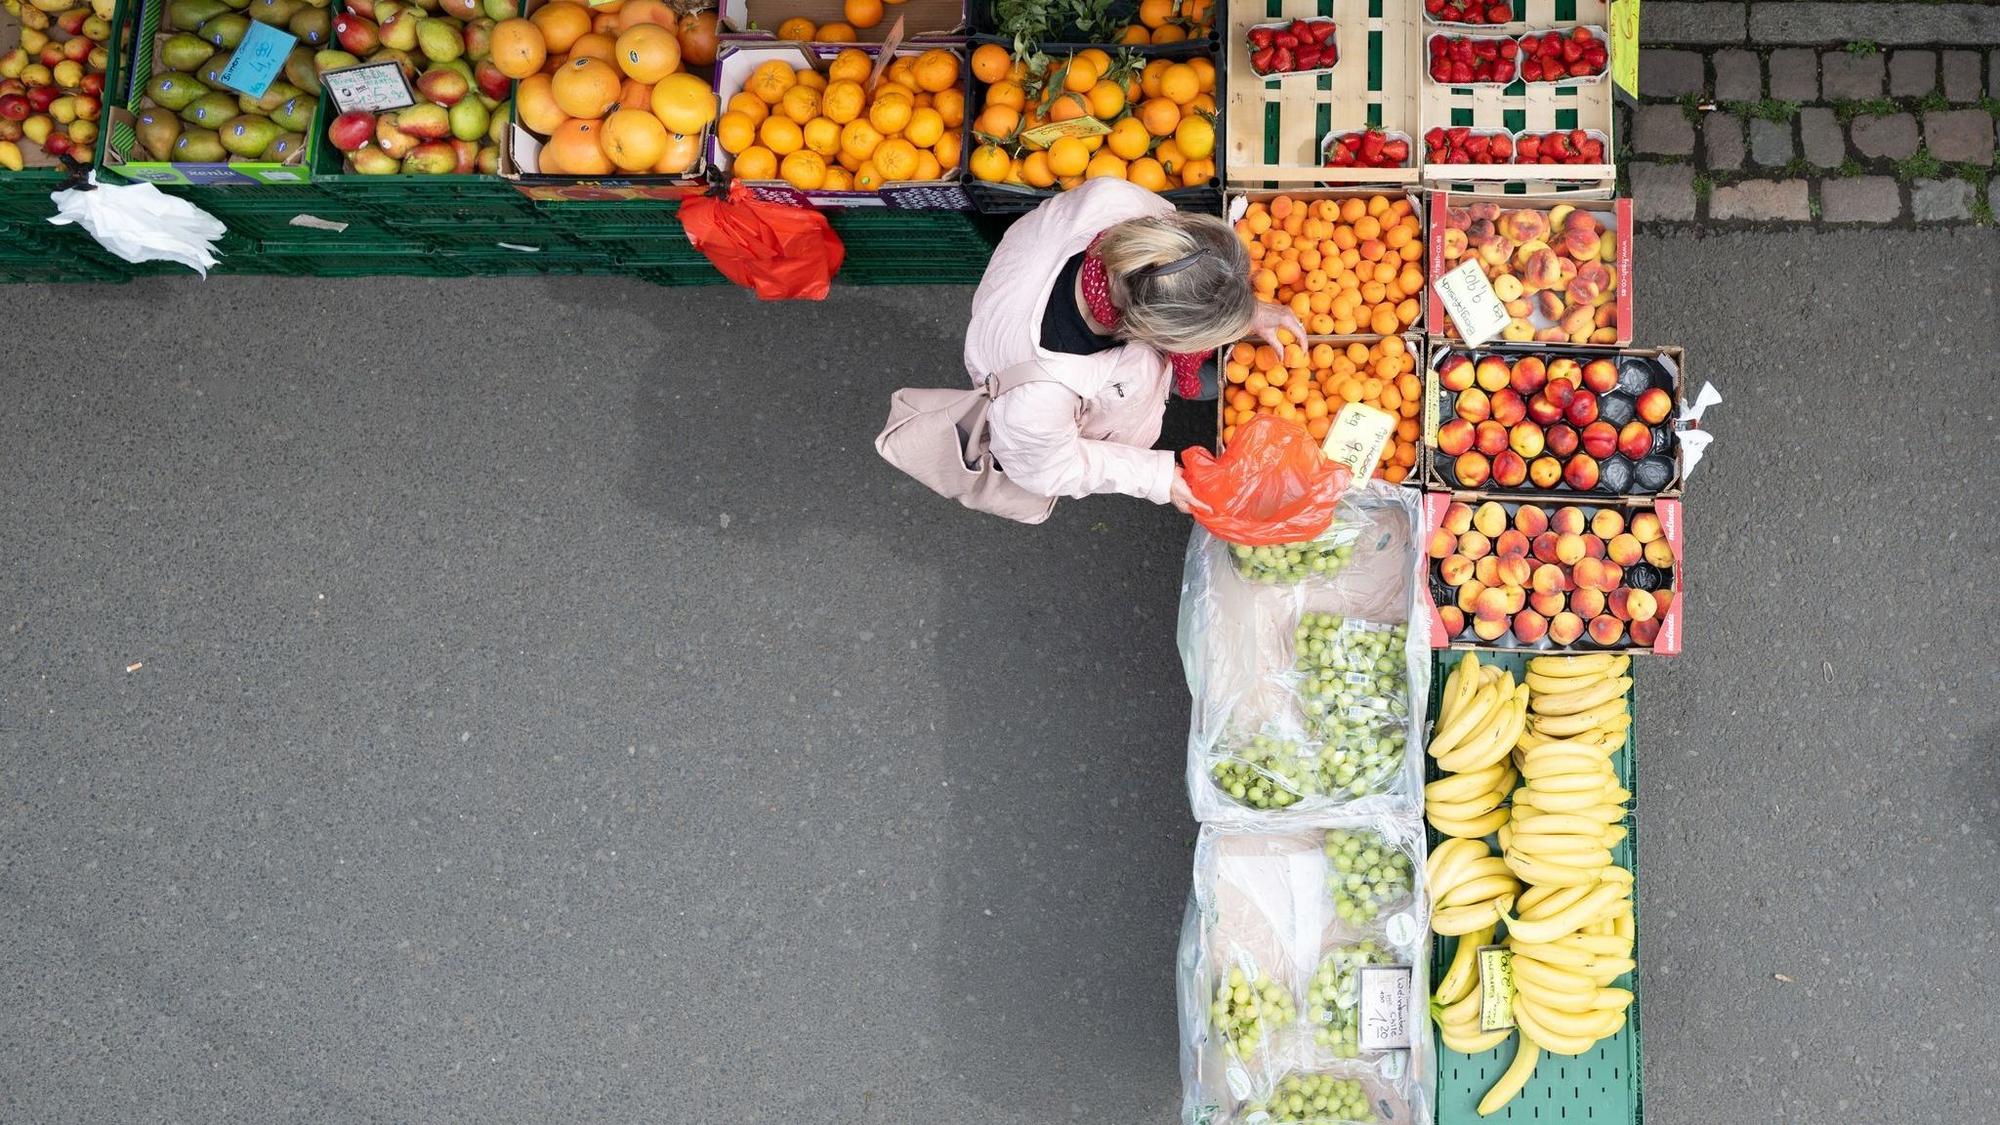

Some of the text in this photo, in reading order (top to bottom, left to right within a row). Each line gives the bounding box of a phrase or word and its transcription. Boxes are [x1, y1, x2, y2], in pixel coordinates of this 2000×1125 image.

[221, 57, 240, 81] Birnen
[1492, 302, 1504, 322] kg
[1345, 411, 1366, 427] kg
